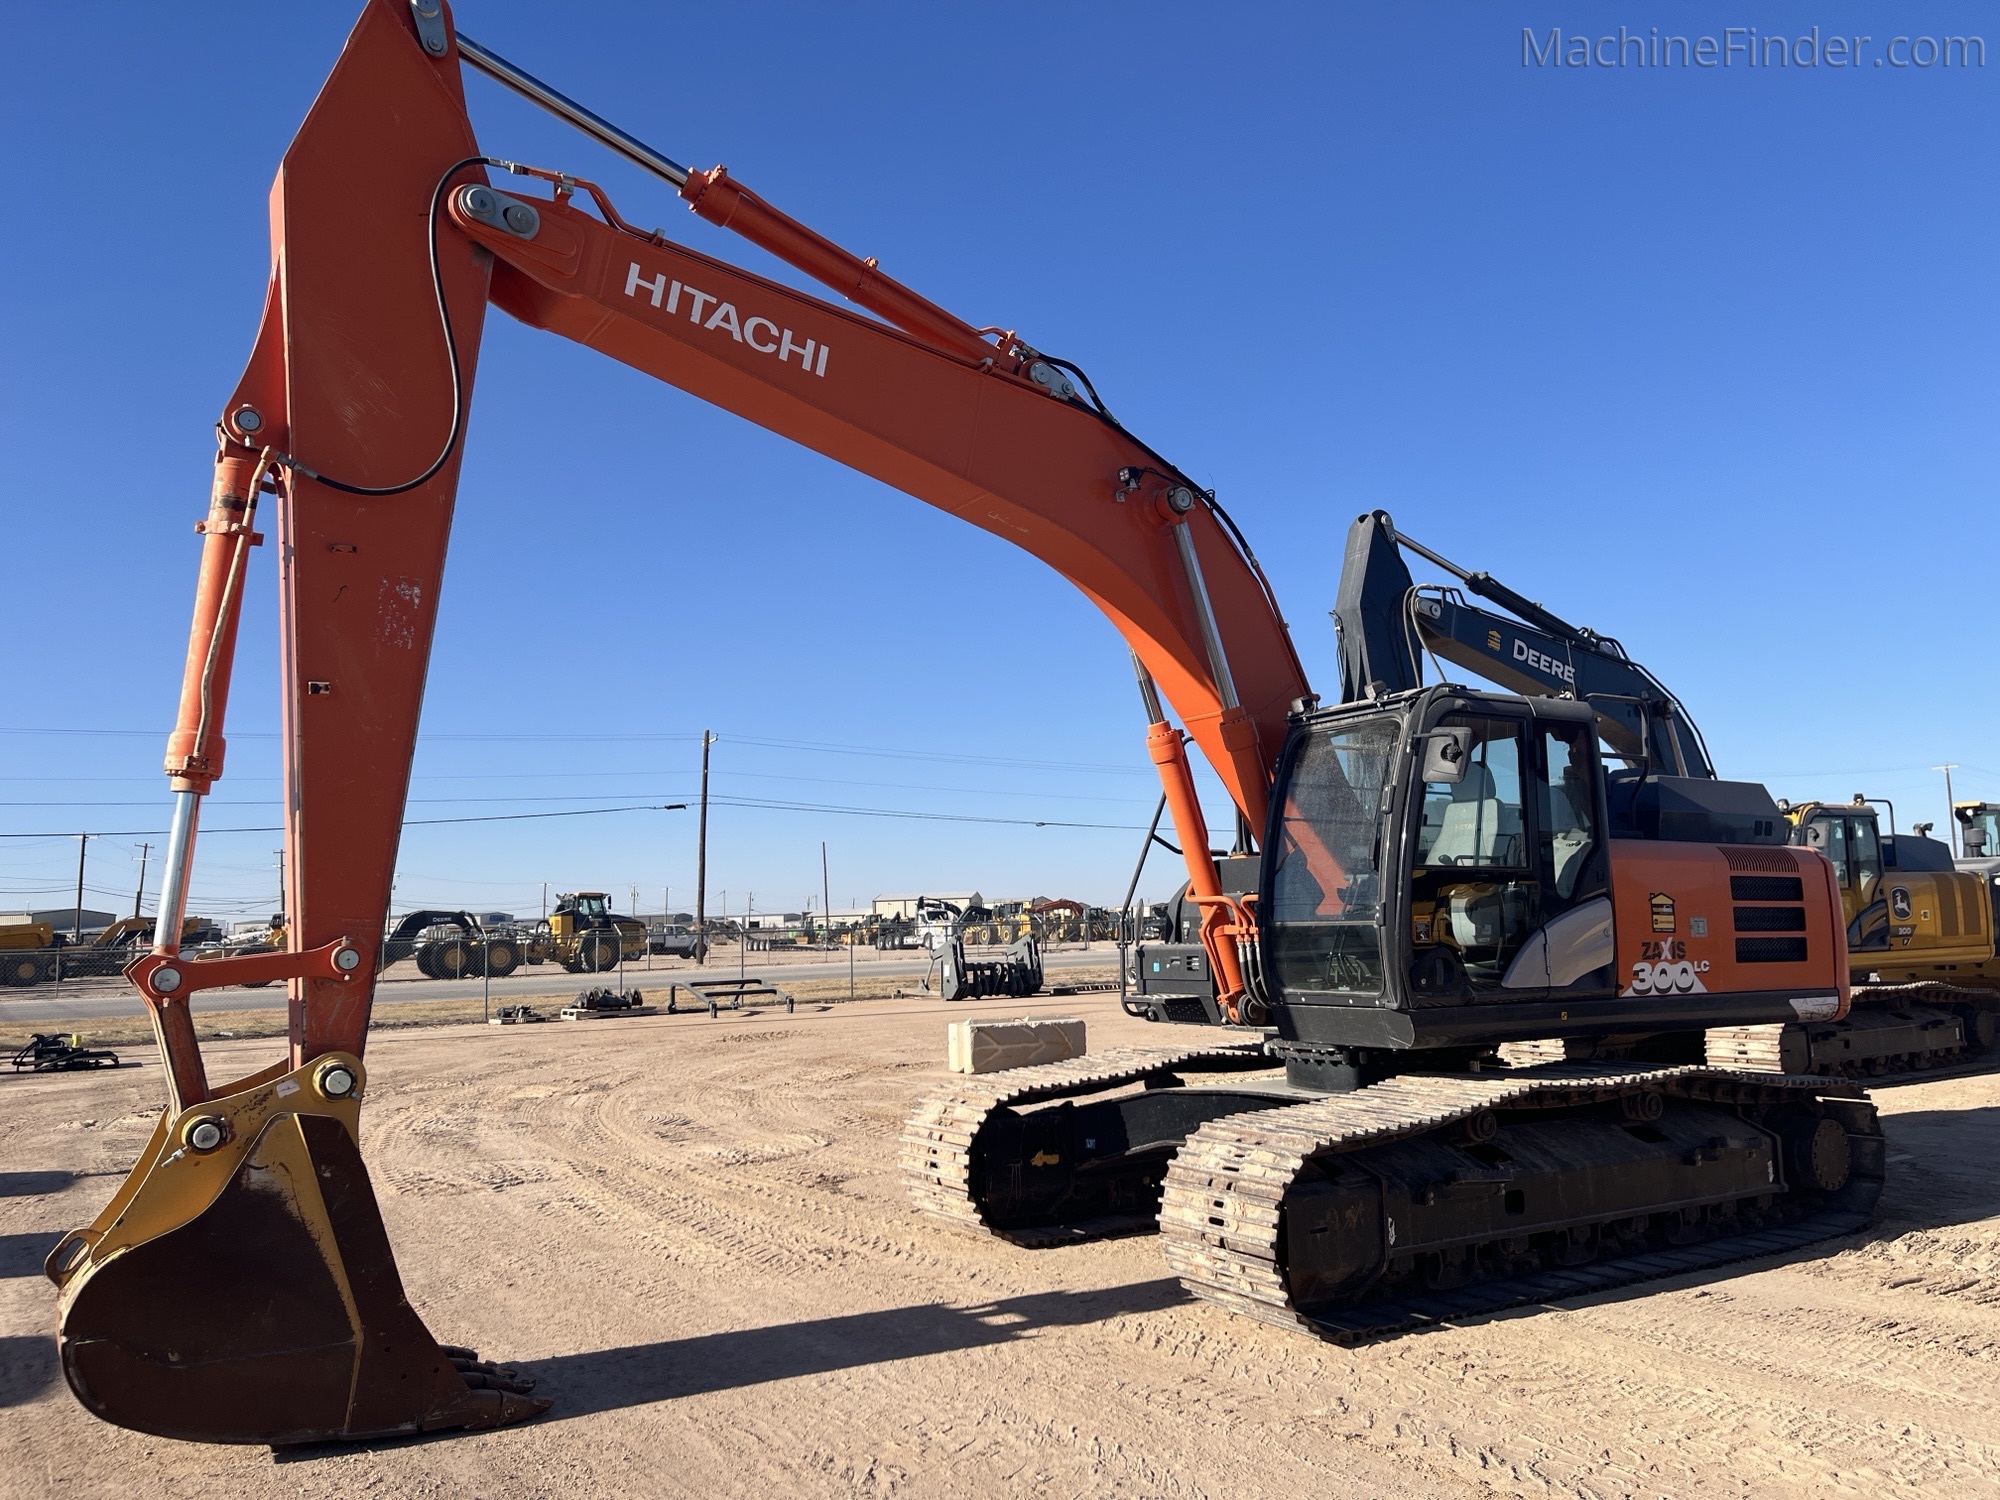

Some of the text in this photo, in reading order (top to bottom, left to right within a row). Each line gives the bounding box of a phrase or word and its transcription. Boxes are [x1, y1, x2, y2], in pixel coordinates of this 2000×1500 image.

[624, 261, 830, 378] HITACHI
[1512, 638, 1575, 684] DEERE
[1641, 937, 1686, 960] ZAXIS
